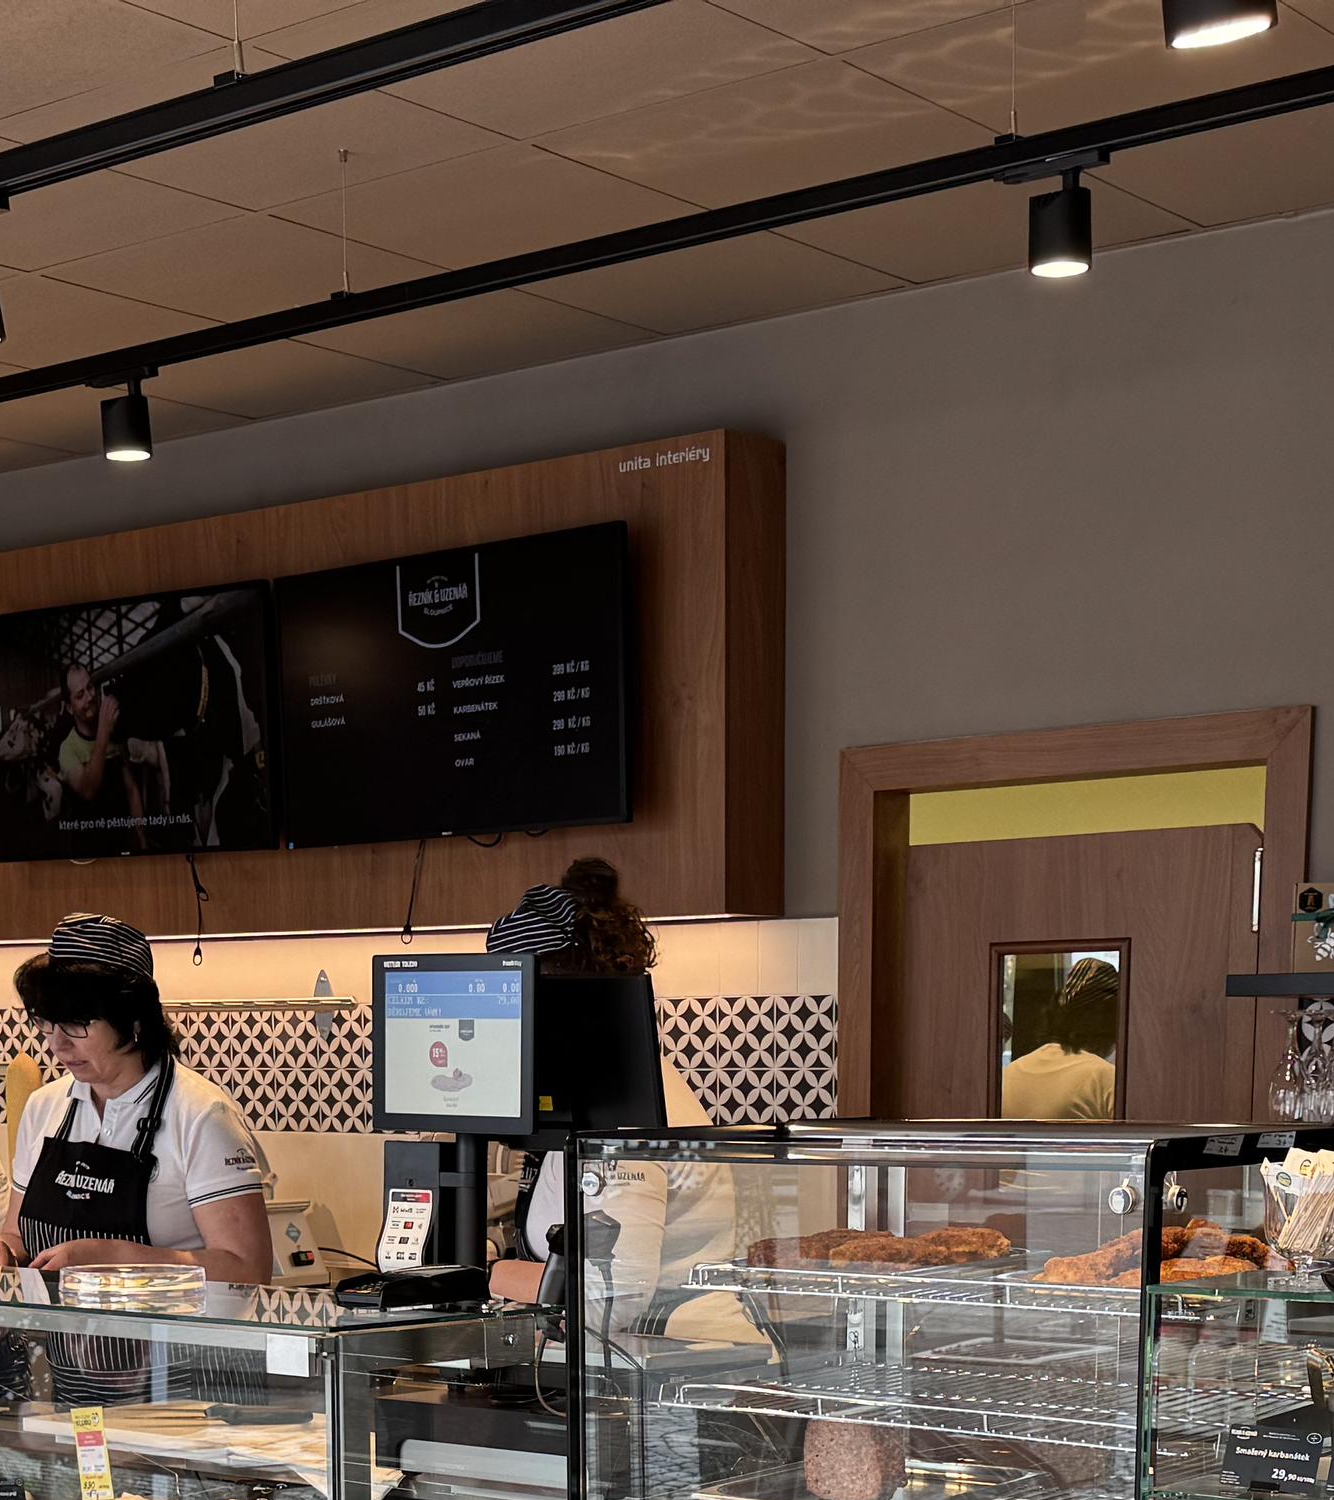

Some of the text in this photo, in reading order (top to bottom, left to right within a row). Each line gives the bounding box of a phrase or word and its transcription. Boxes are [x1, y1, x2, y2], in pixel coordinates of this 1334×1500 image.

[619, 446, 710, 472] unita interiéry
[1235, 1446, 1310, 1461] Smažený karbanátek
